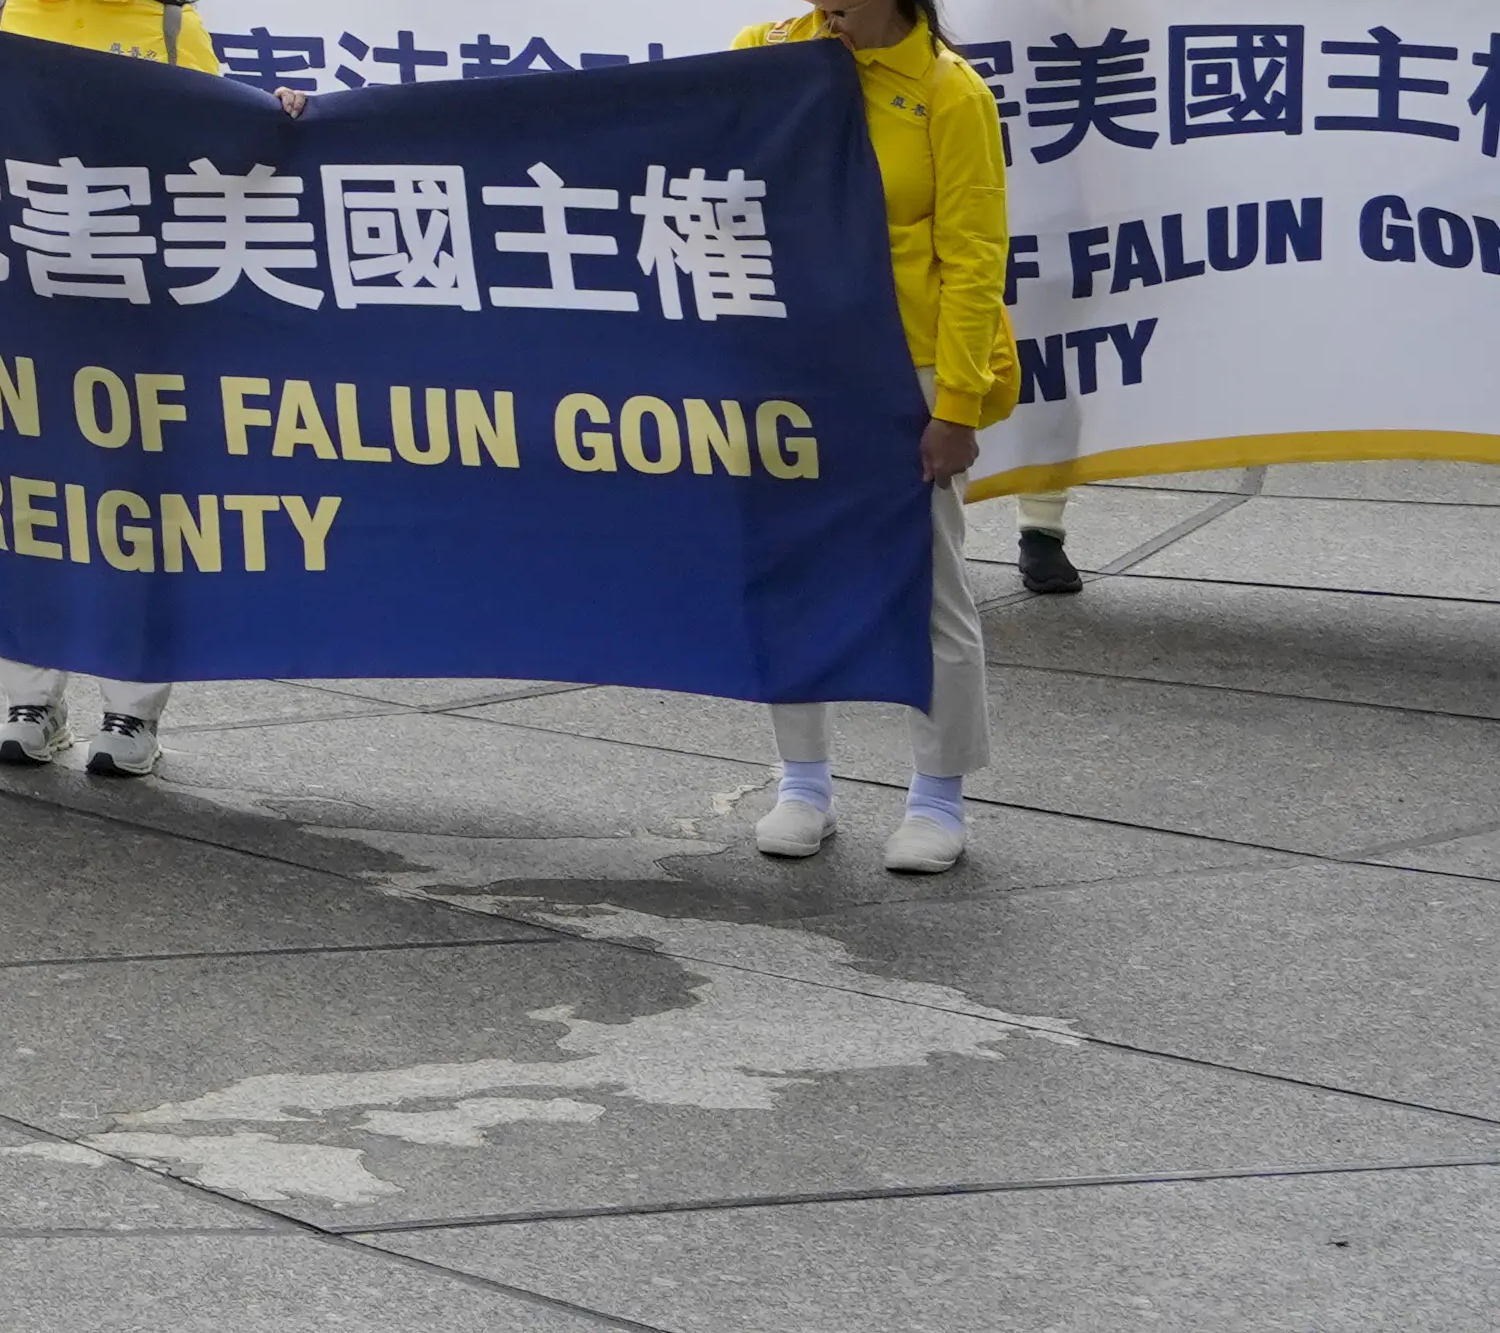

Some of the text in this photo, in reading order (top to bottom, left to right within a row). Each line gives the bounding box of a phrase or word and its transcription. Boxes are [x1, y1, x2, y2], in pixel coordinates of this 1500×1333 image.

[1067, 195, 1325, 299] FALUN
[74, 365, 187, 451] OF
[221, 376, 520, 469] FALUN
[554, 393, 820, 480] GONG
